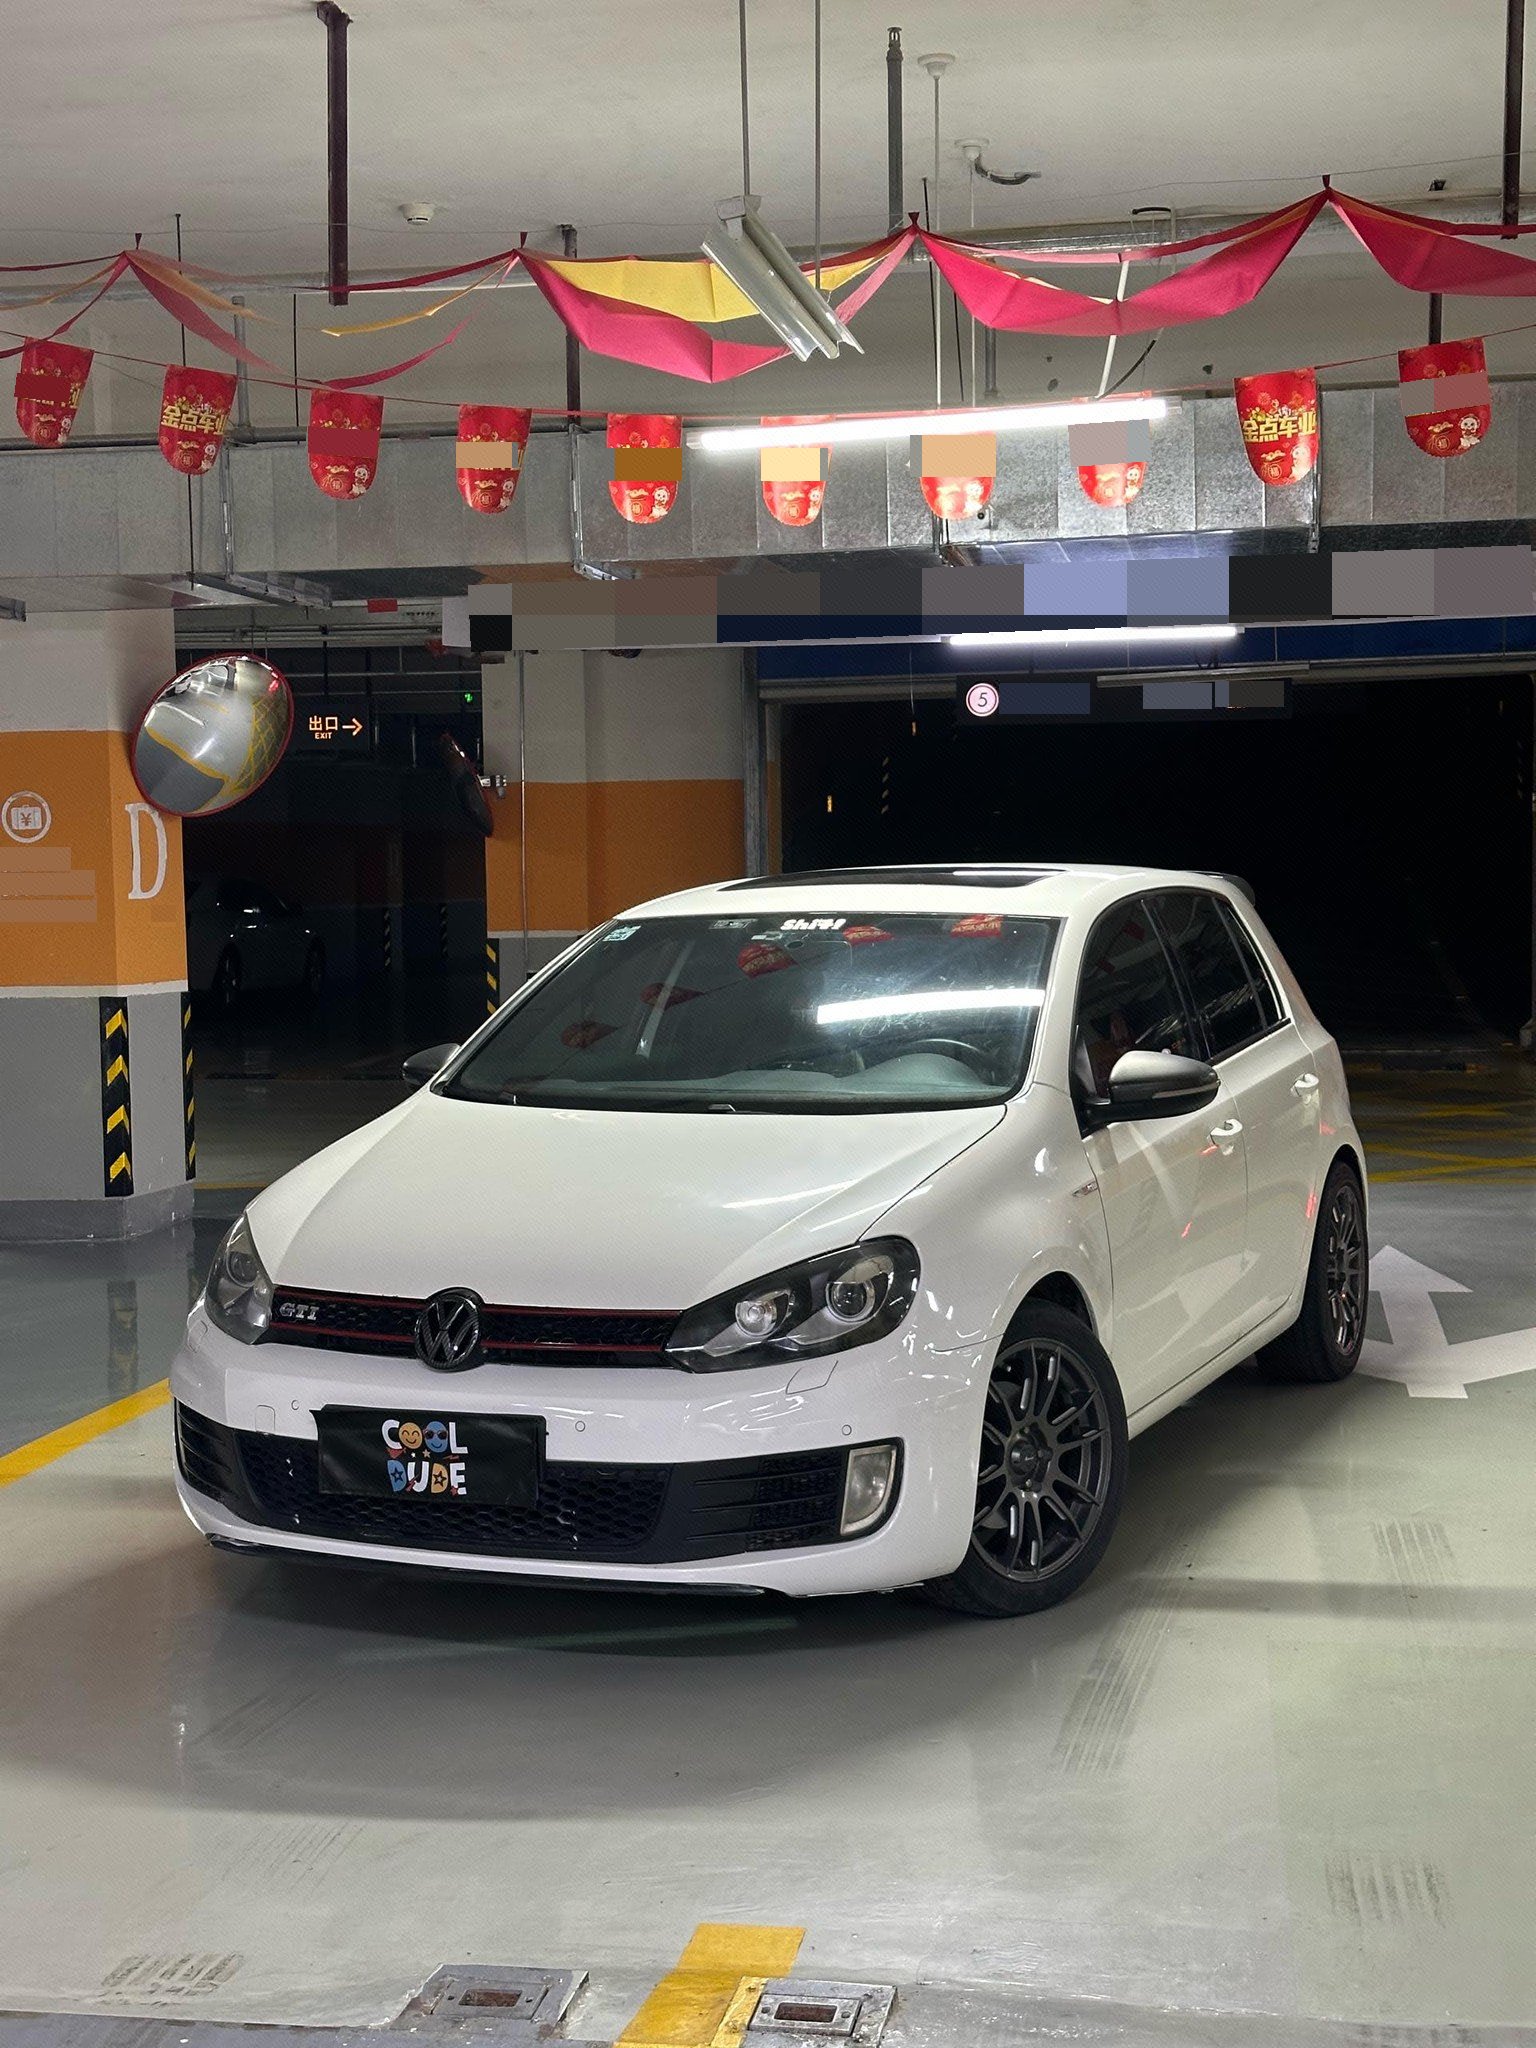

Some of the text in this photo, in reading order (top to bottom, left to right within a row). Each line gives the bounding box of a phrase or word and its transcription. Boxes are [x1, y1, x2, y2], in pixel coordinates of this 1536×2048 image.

[161, 403, 229, 436] 金点车业
[309, 715, 338, 731] 出口
[314, 732, 333, 740] EXIT
[125, 802, 168, 900] D
[279, 1302, 320, 1321] GTI
[381, 1419, 469, 1454] COOL
[387, 1459, 468, 1495] DUDE
